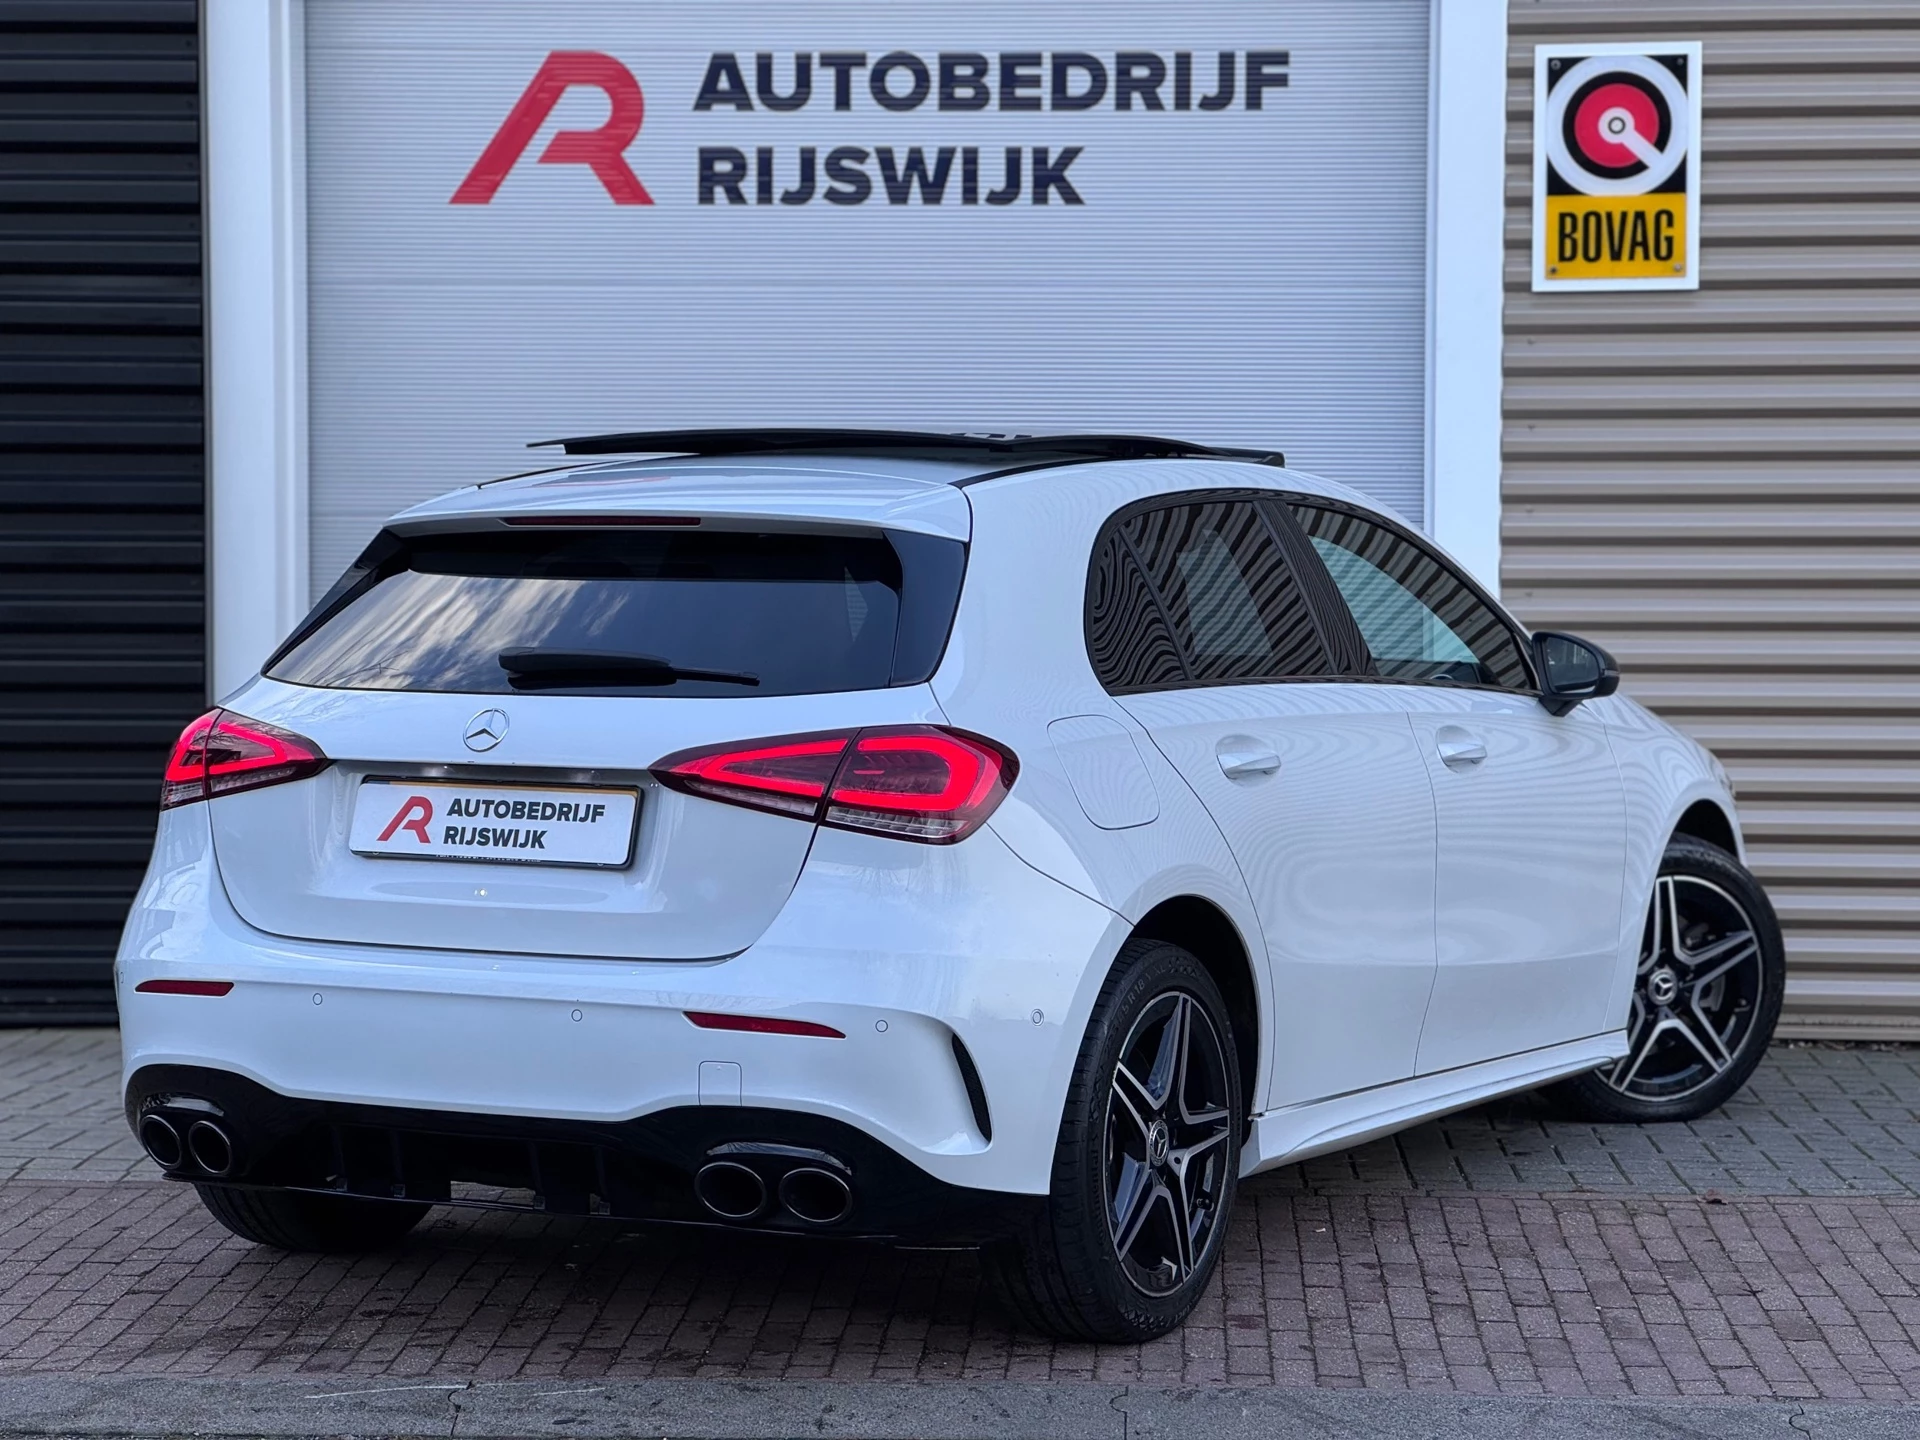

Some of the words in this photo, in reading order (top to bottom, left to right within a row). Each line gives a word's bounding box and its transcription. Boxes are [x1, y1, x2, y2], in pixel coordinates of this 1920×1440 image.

[693, 51, 1290, 112] AUTOBEDRIJF
[698, 146, 1084, 205] RIJSWIJK
[1557, 209, 1675, 263] BOVAG
[443, 826, 548, 849] RIJSWIJK
[447, 798, 606, 823] AUTOBEDRIJF
